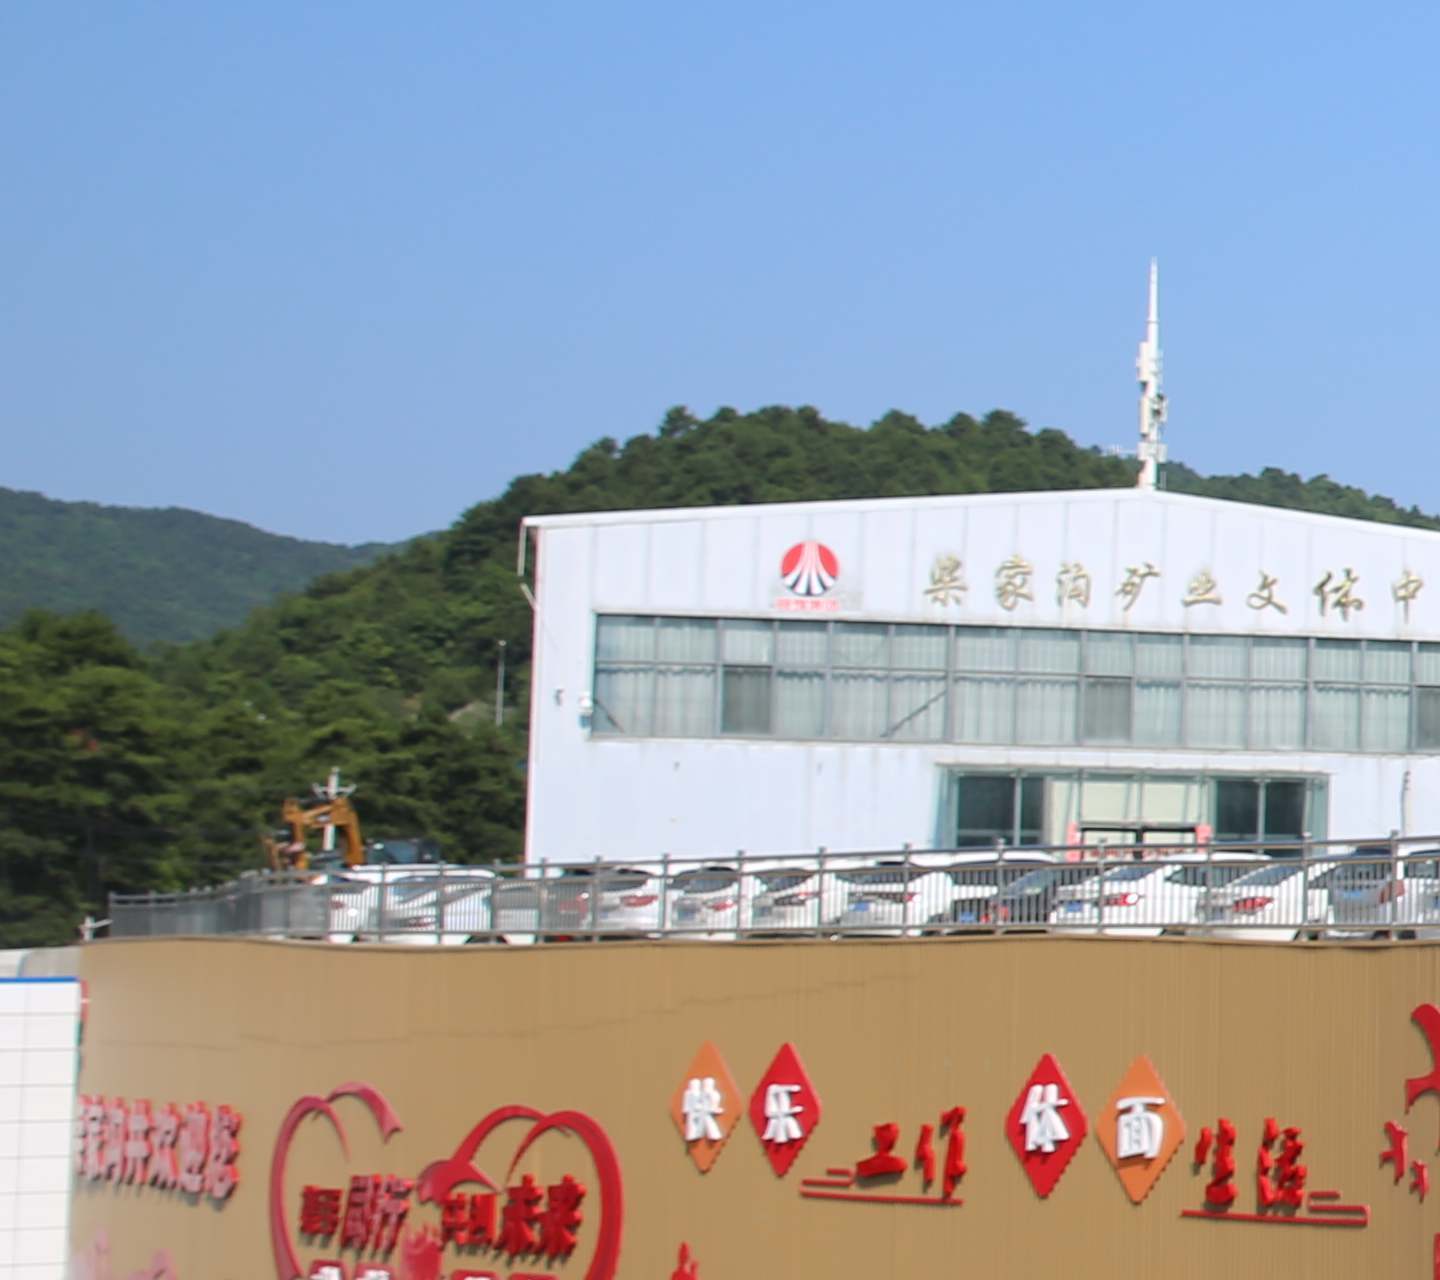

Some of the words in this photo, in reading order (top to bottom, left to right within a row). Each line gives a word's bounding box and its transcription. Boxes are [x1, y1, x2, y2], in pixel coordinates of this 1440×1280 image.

[682, 1077, 968, 1201] 快乐工作
[1019, 1083, 1308, 1210] 体面生活
